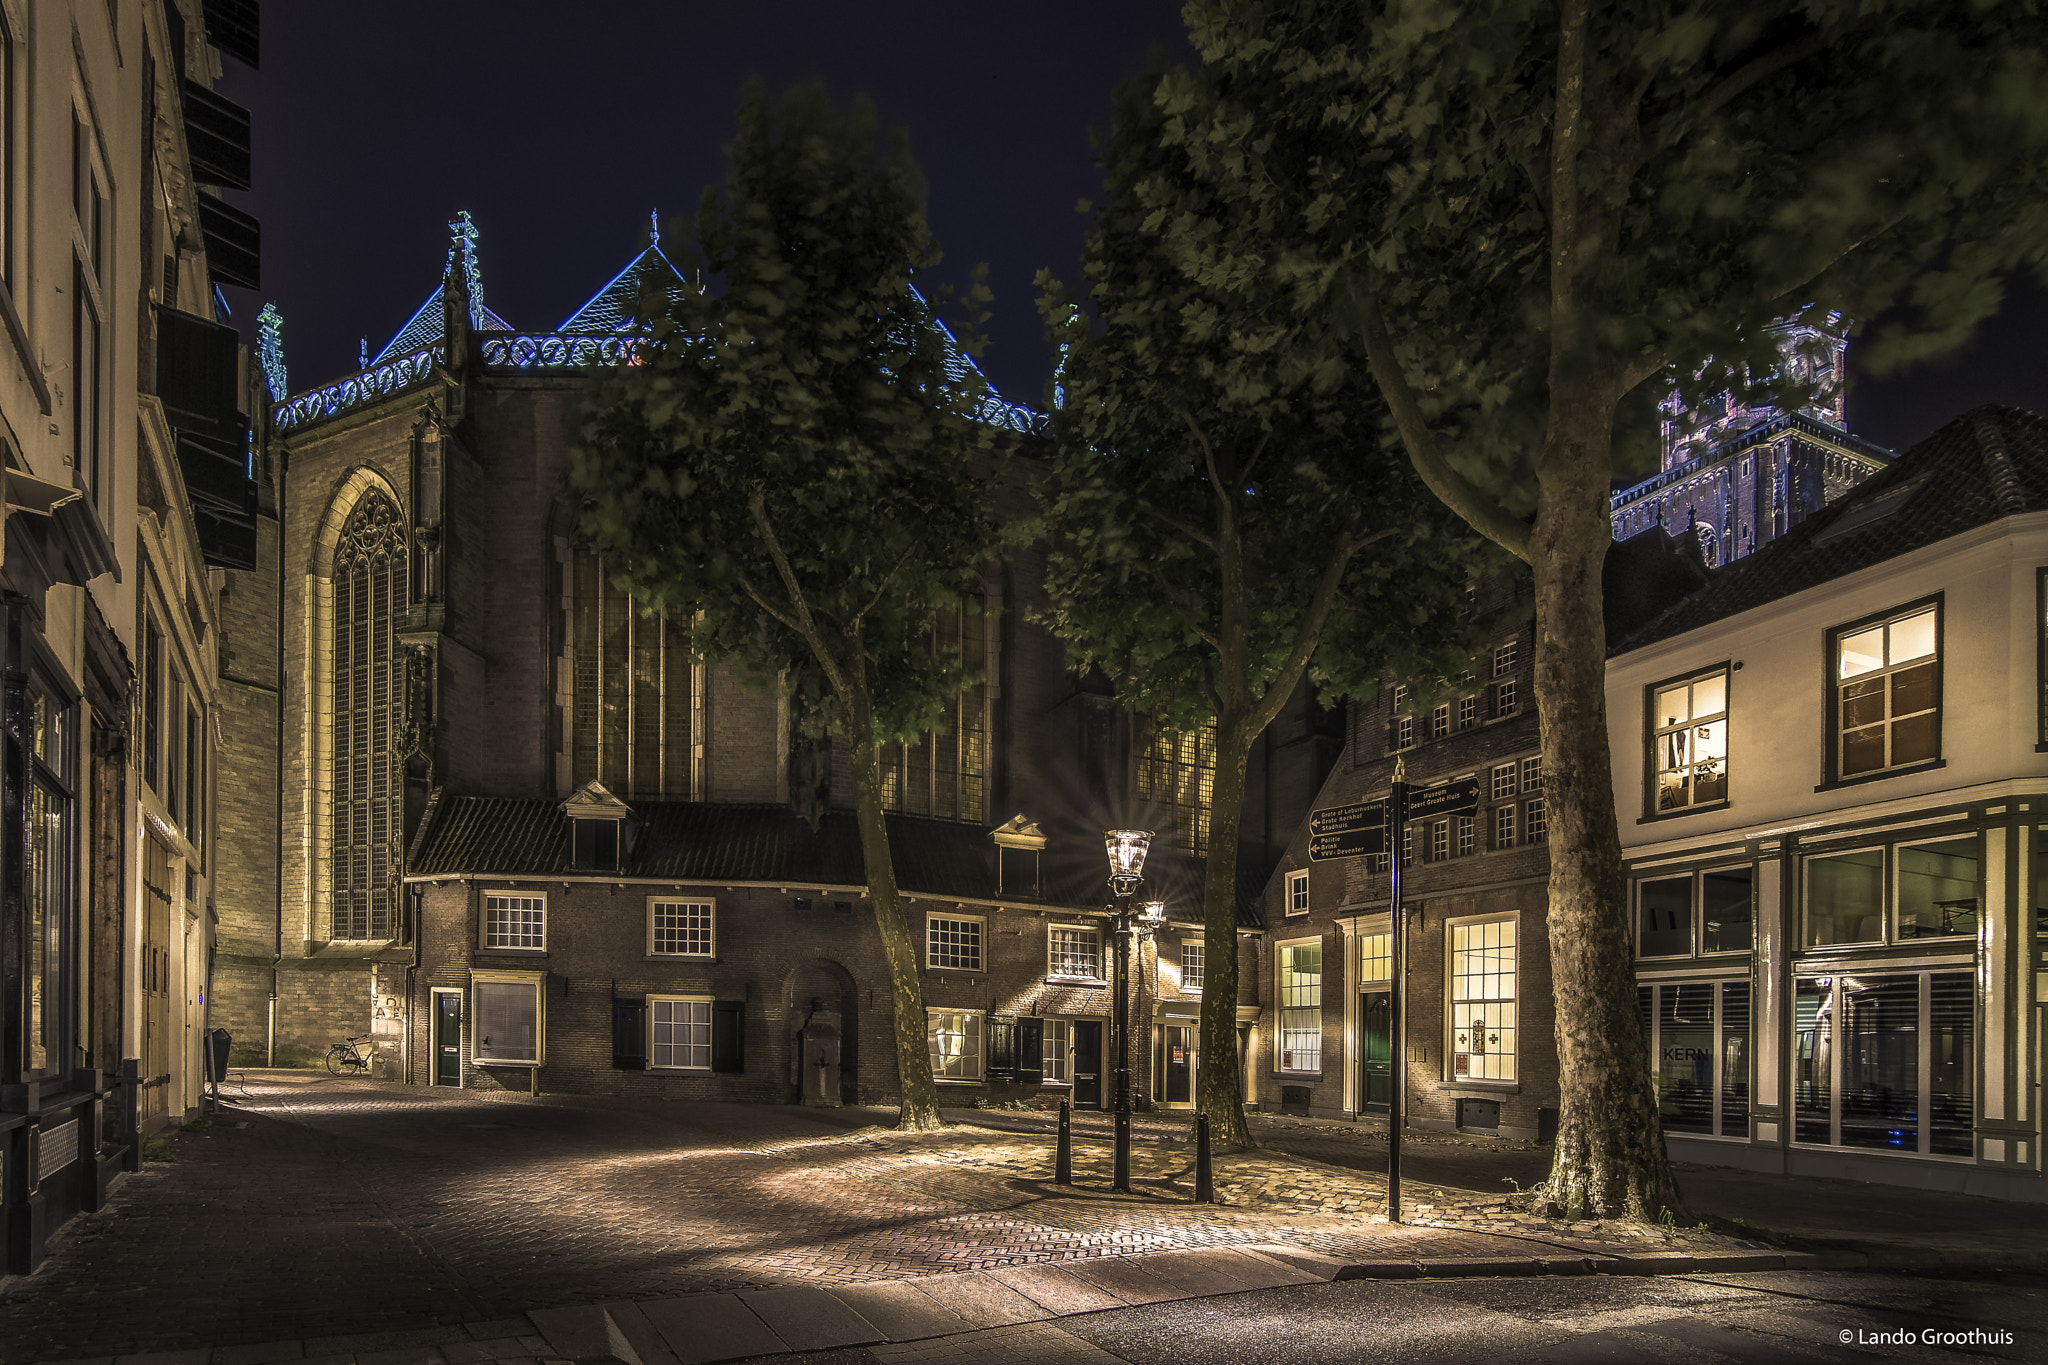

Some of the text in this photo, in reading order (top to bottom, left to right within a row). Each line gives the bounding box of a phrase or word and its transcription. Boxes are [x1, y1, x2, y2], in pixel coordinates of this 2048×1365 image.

[1423, 789, 1447, 799] Museum
[1410, 801, 1426, 809] Geert
[1447, 793, 1460, 801] Huis
[1339, 813, 1363, 821] Kerkhof
[1321, 822, 1348, 831] Stadhuis
[1664, 1048, 1708, 1060] KERN
